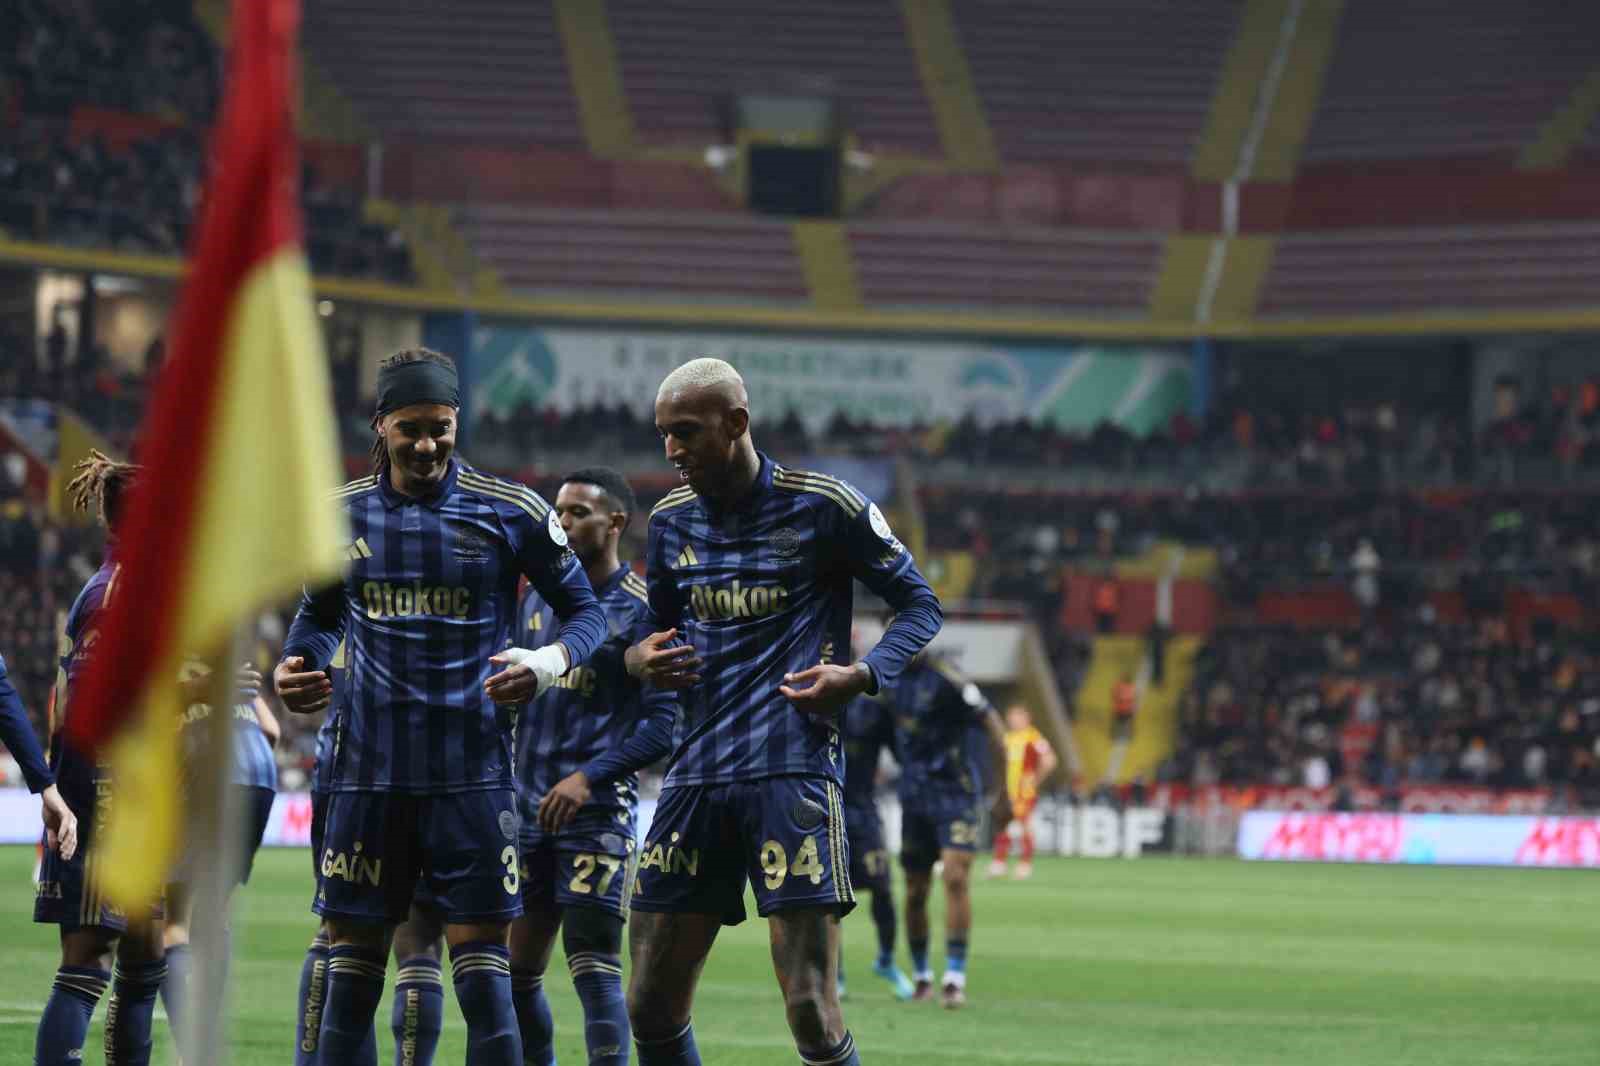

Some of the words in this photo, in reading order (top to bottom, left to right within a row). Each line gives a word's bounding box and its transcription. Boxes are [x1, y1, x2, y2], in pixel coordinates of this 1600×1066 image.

[501, 845, 520, 896] 3
[569, 854, 620, 895] 27
[760, 835, 824, 890] 94
